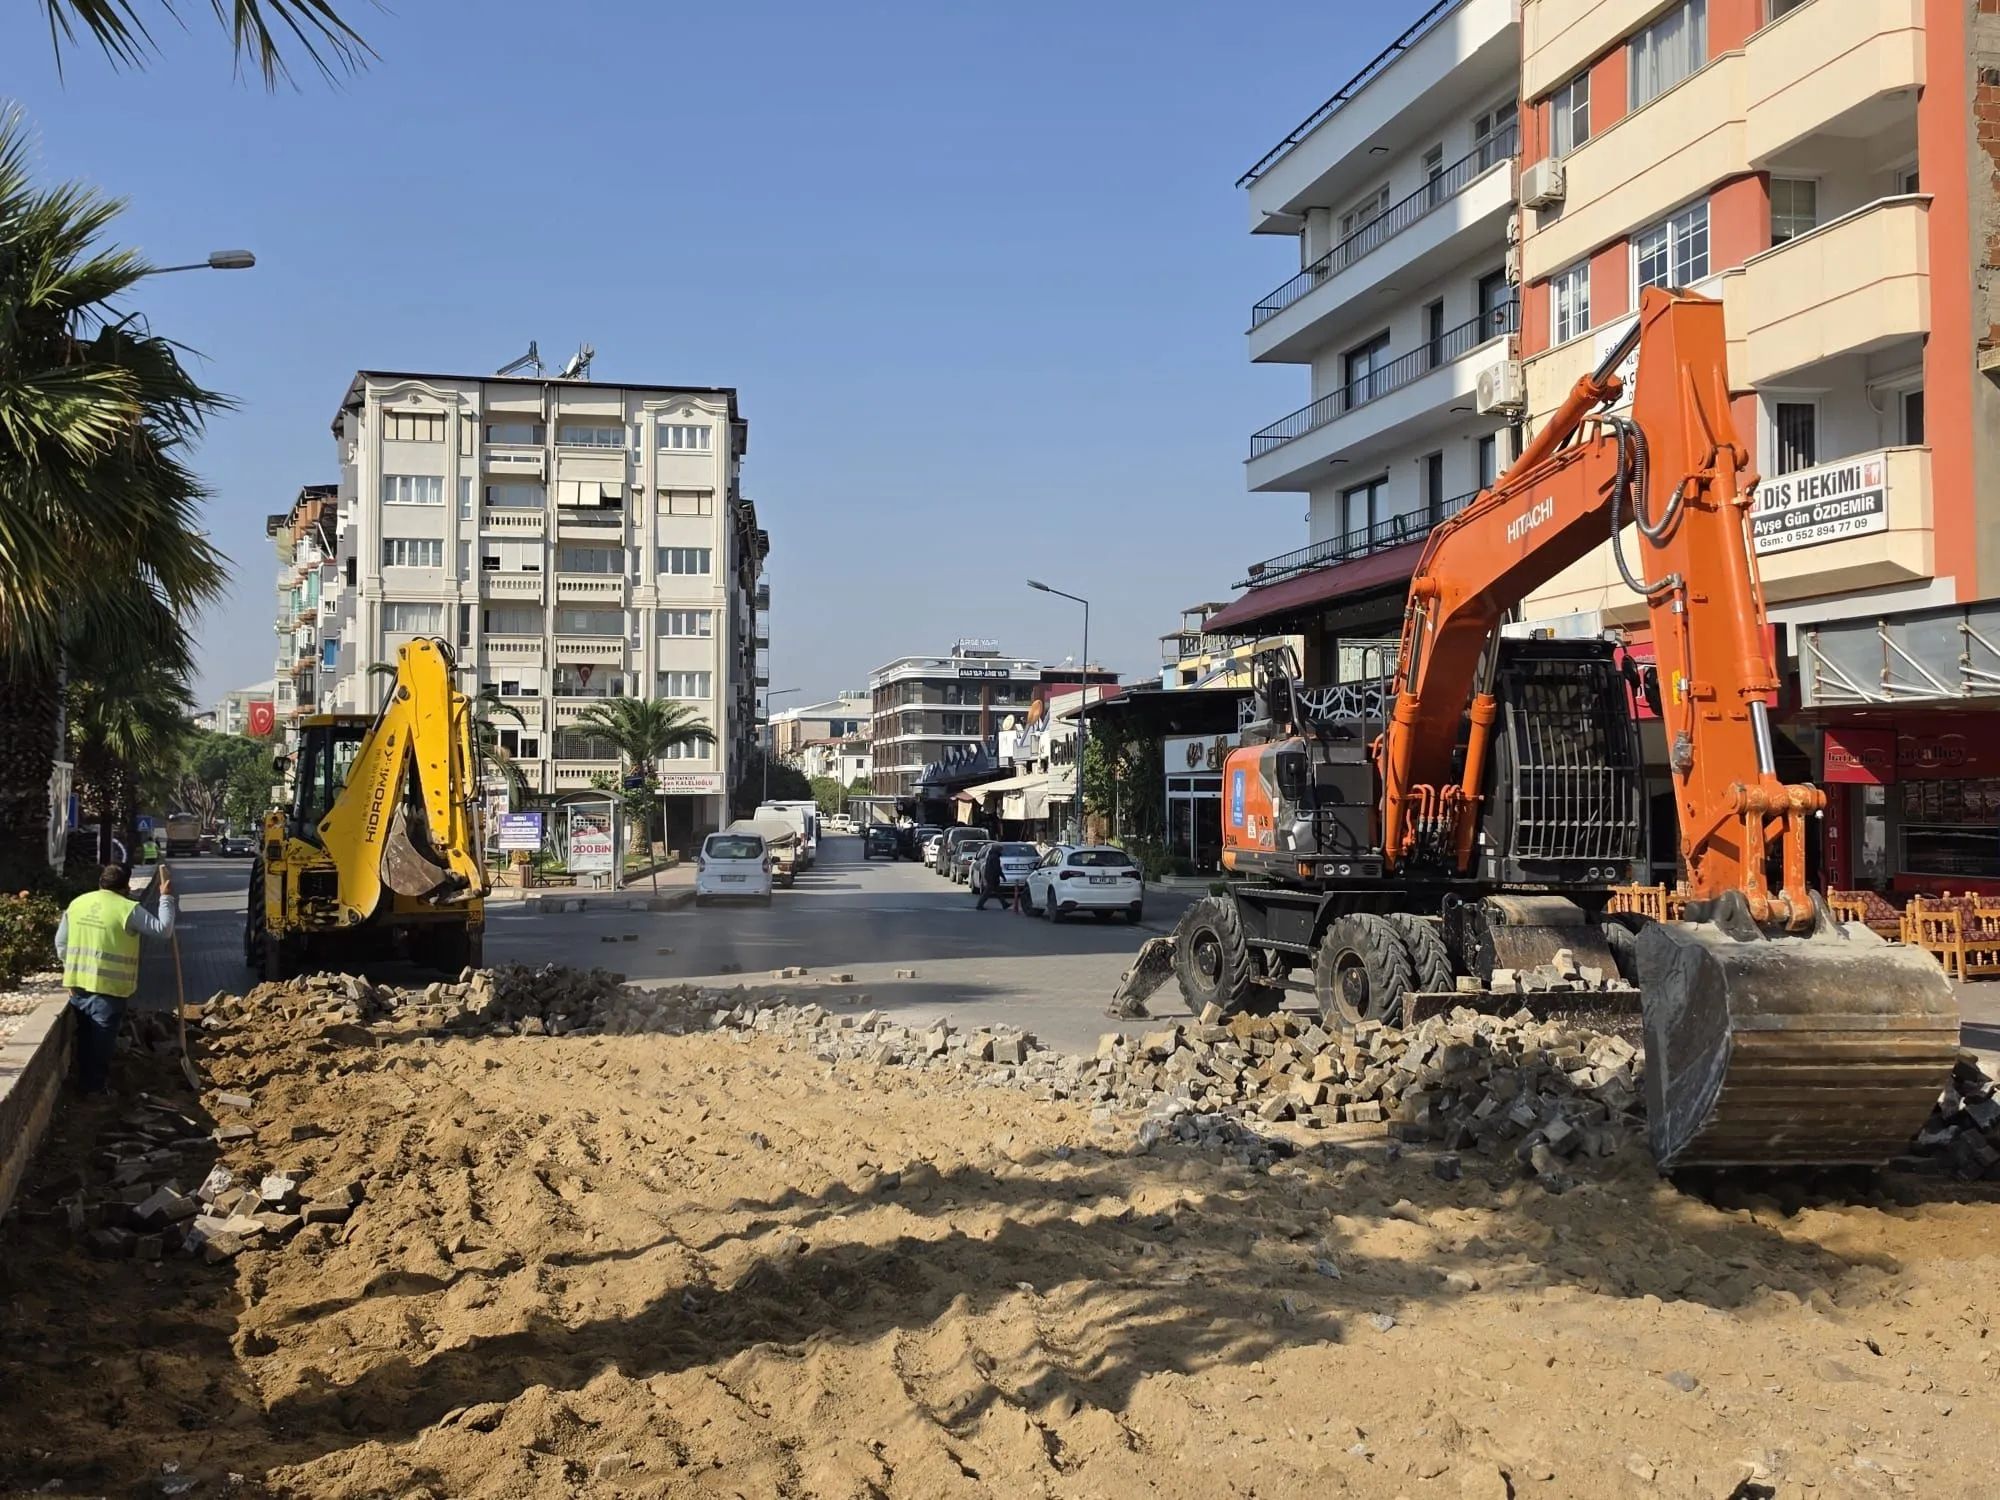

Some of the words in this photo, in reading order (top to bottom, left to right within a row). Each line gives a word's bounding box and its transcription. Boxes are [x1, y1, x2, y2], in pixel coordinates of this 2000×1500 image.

[1507, 496, 1553, 544] HITACHI
[1753, 519, 1782, 535] Ayşe
[1785, 511, 1810, 527] Gün
[1813, 494, 1875, 521] ÖZDEMİR
[1760, 536, 1784, 547] Gsm:
[1786, 533, 1793, 542] 0
[1795, 529, 1814, 541] 552
[1816, 525, 1835, 537] 894
[1838, 521, 1851, 532] 77
[1854, 518, 1868, 529] 09
[573, 845, 593, 853] 200
